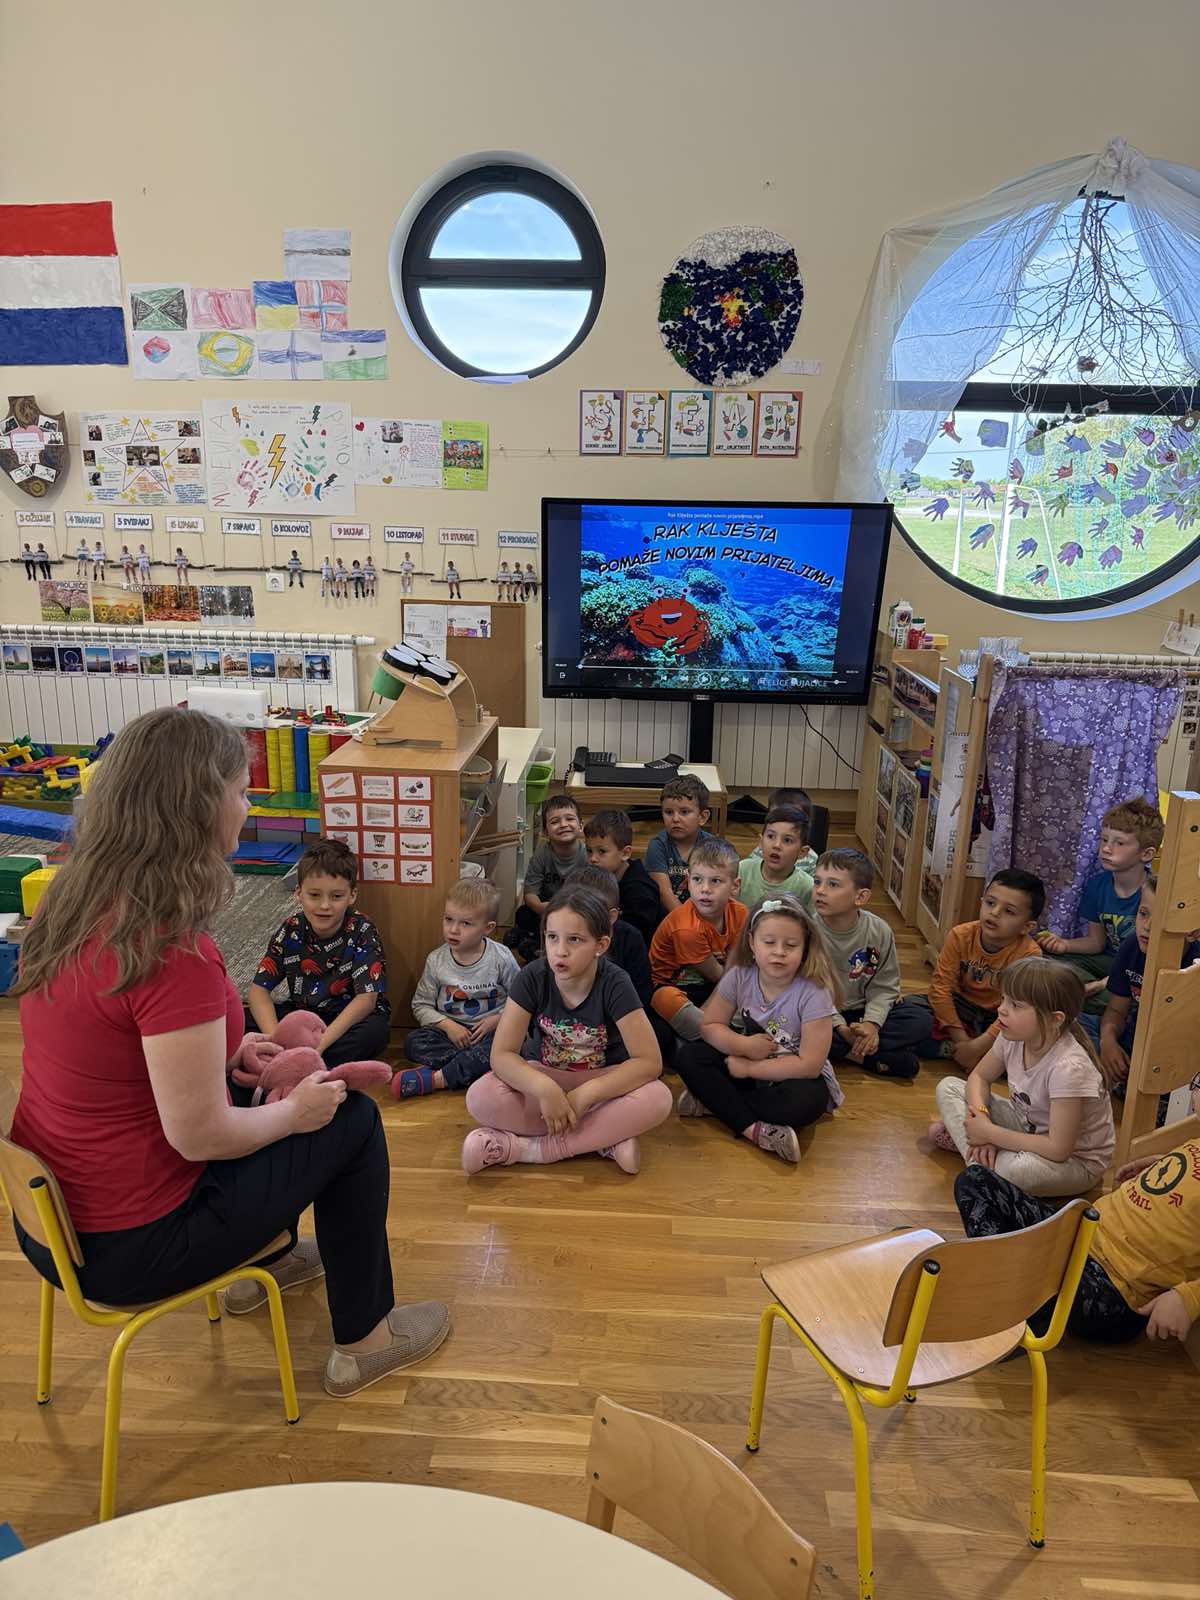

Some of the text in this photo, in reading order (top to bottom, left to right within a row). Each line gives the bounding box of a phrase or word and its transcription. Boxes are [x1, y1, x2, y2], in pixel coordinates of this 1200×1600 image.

[117, 517, 150, 527] 5 SVIBANJ
[273, 523, 309, 534] 8 KOLOVOZ
[337, 527, 364, 537] 9 RUJAN
[653, 522, 778, 544] RAK KLJEŠTA
[386, 530, 423, 540] 10 LISTOPAD
[441, 532, 449, 541] 11
[499, 535, 507, 544] 12
[599, 546, 836, 589] POMAŽE NOVIM PRIJATELJIMA
[462, 982, 497, 990] ORIGINAL
[1126, 1185, 1152, 1211] TRAIL
